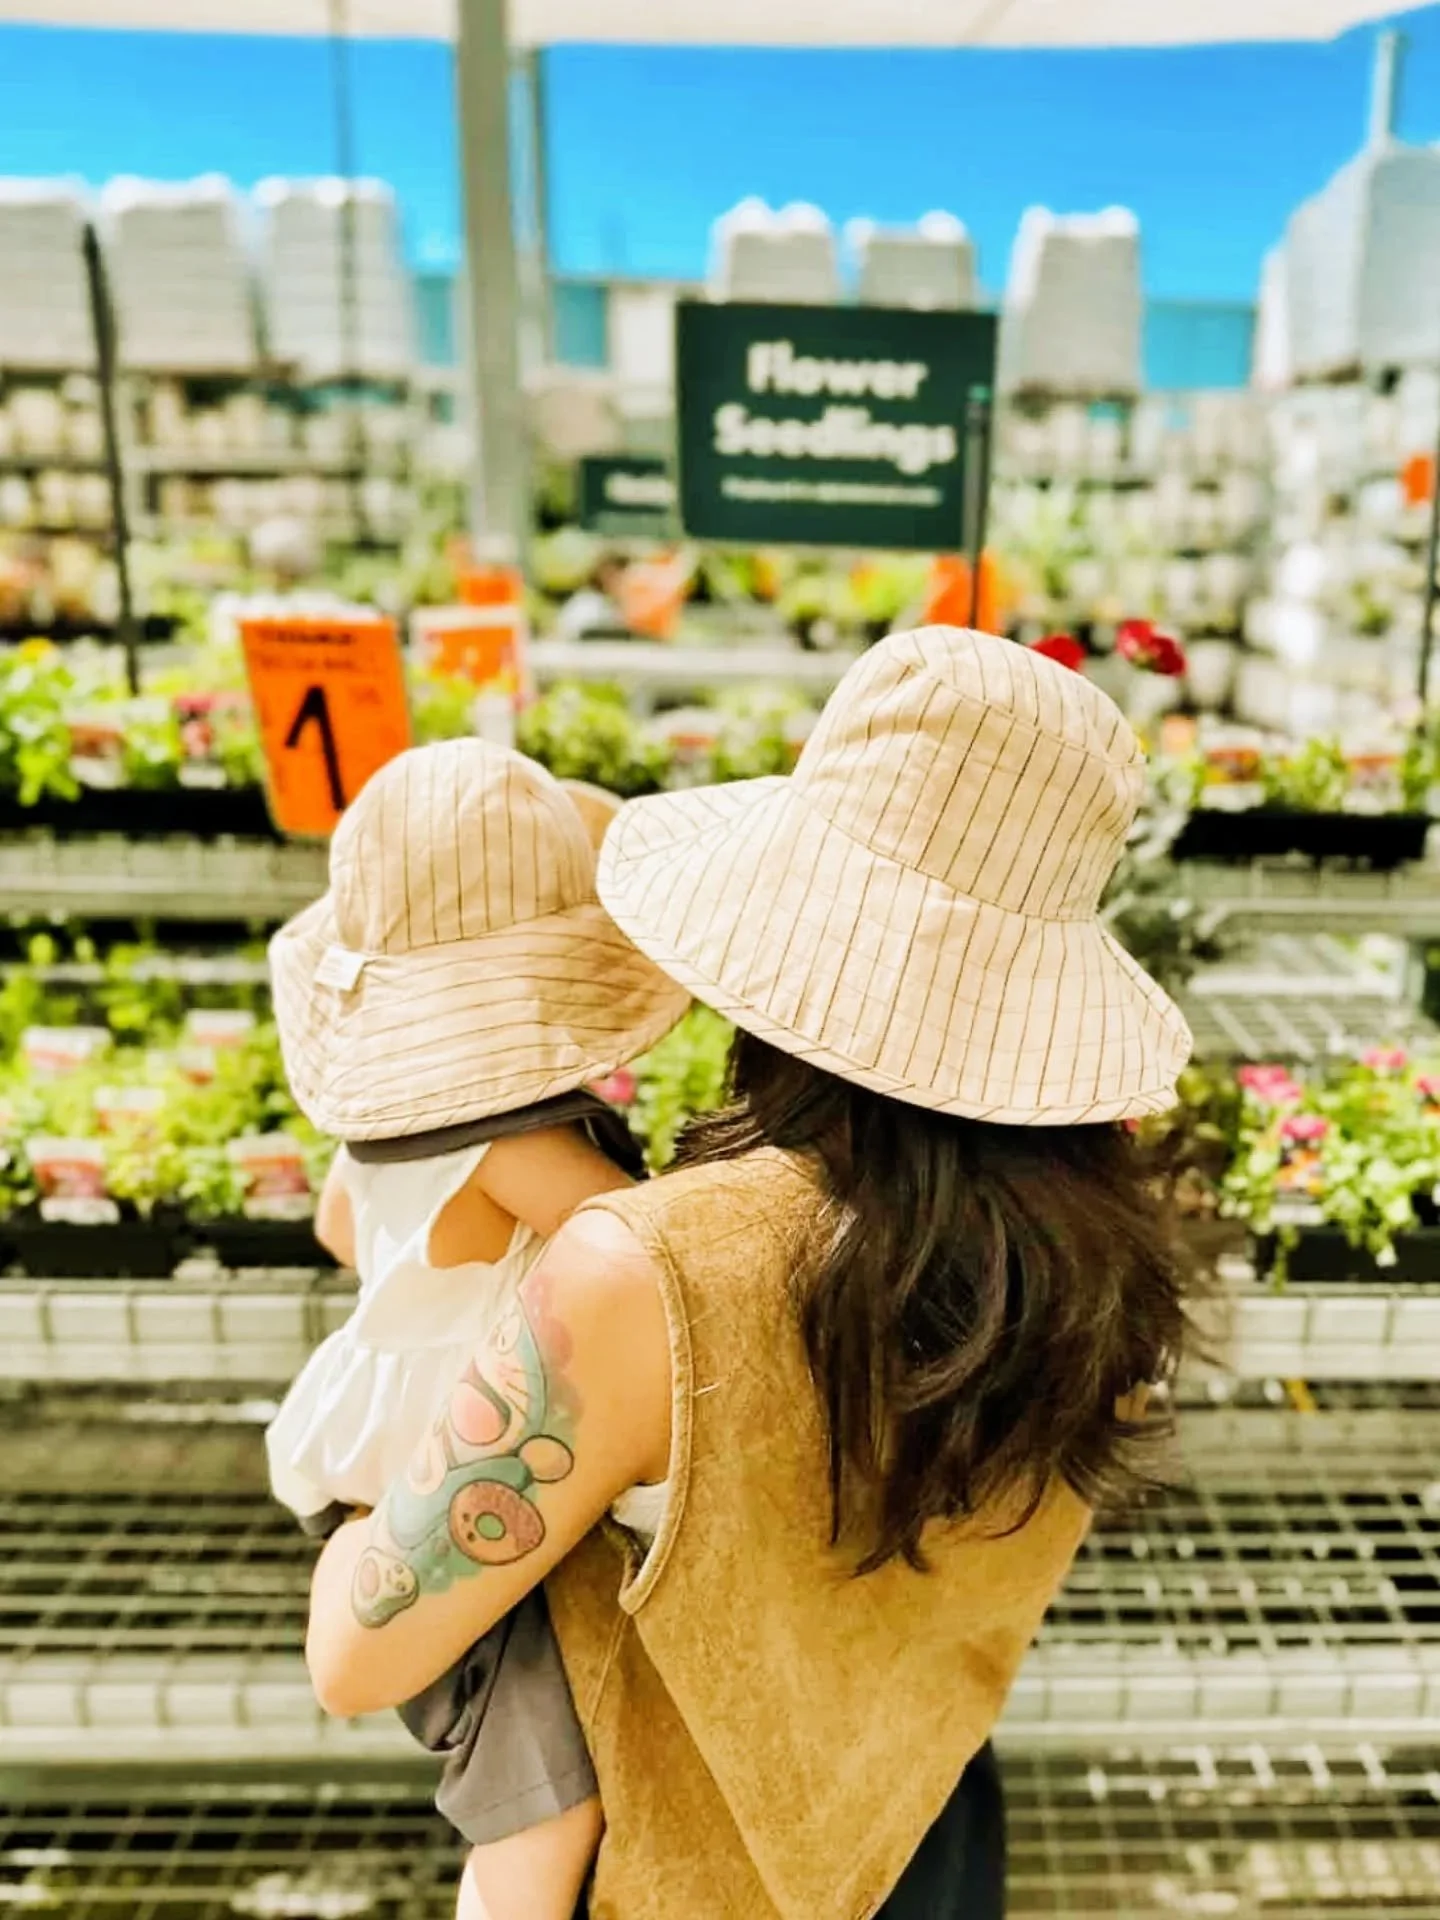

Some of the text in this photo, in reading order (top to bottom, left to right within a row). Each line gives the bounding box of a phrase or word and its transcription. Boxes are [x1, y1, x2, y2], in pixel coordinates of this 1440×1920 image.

[746, 339, 928, 399] Flower
[713, 402, 957, 475] Seedlings
[285, 684, 346, 812] 1
